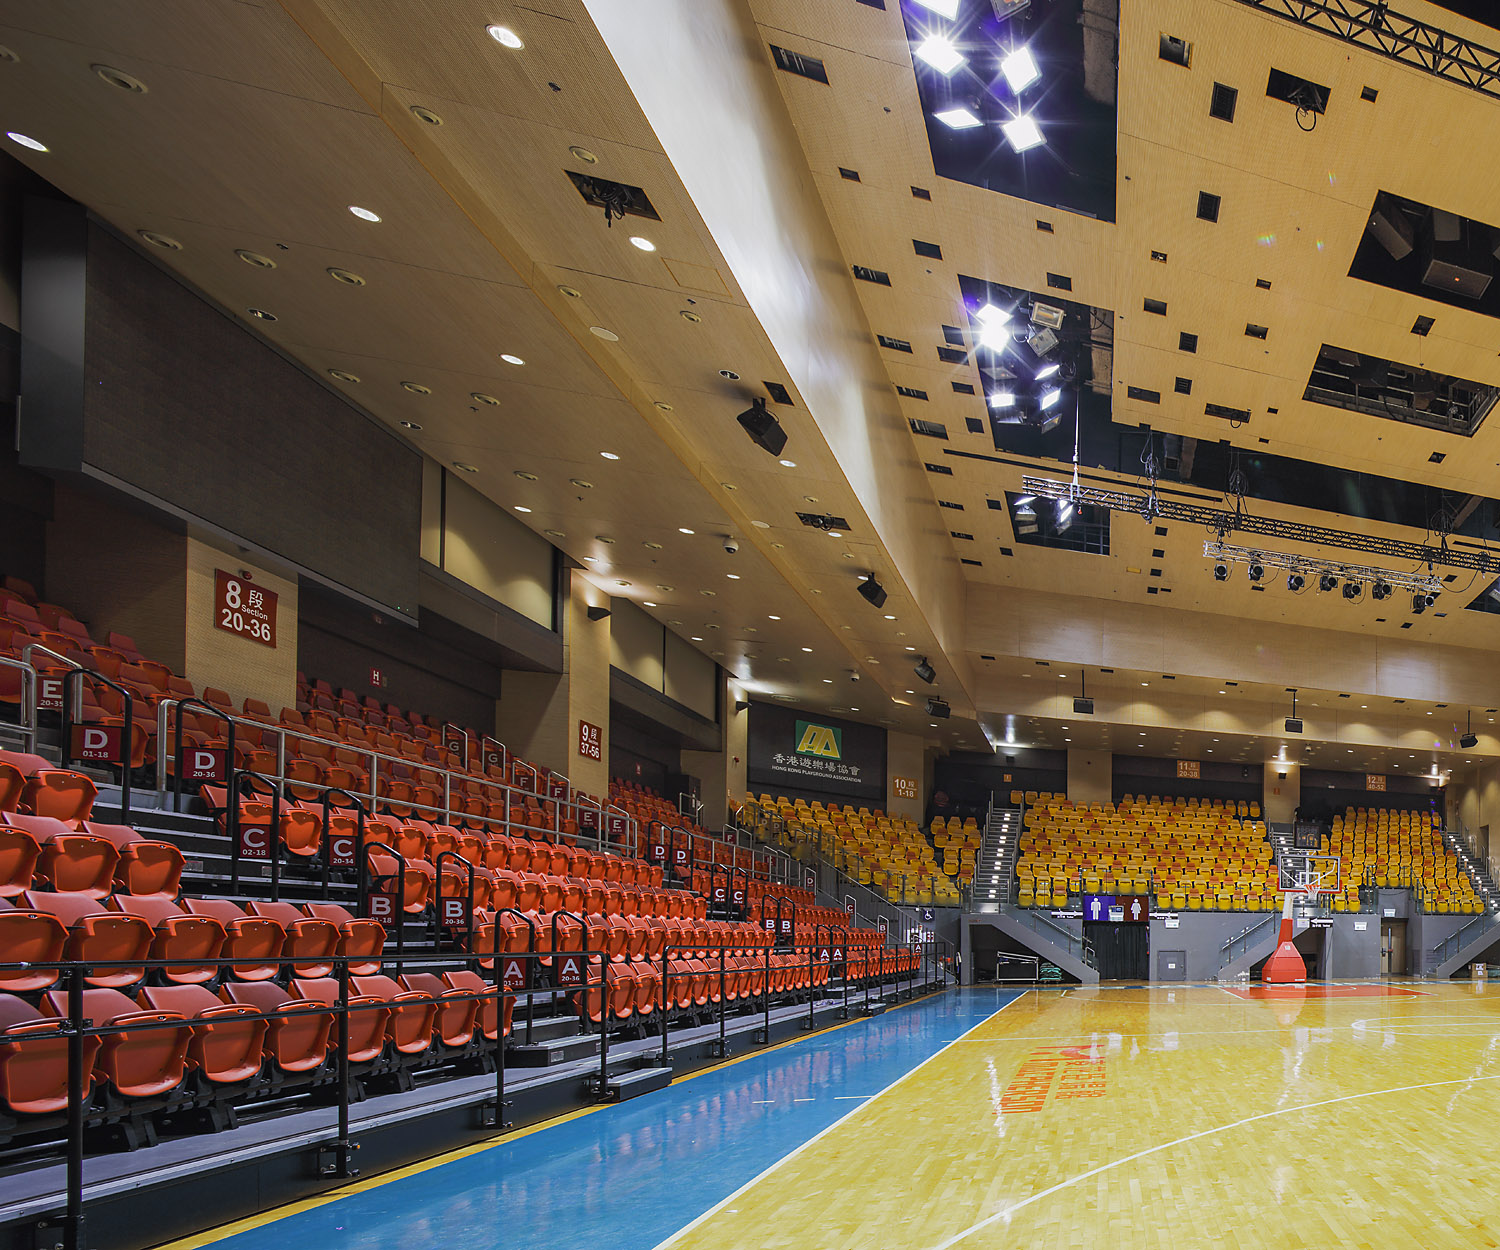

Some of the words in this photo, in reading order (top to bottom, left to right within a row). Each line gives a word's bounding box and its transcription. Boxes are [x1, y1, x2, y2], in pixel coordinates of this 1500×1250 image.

[226, 580, 242, 609] 8
[248, 590, 264, 610] 段
[241, 604, 268, 621] Section
[222, 608, 271, 642] 20-36
[374, 670, 379, 681] H
[42, 680, 62, 699] E
[582, 724, 589, 742] 9
[84, 730, 108, 749] D
[449, 742, 459, 751] G
[581, 742, 600, 758] 37-56
[195, 752, 216, 770] D
[488, 753, 498, 763] G
[802, 770, 832, 779] PLAYGROUND
[833, 774, 862, 783] ASSOCIATION
[520, 777, 528, 787] F
[894, 779, 906, 789] 10
[554, 788, 562, 796] F
[898, 789, 913, 797] 1-18
[584, 812, 592, 821] E
[613, 820, 621, 828] E
[244, 828, 266, 848] C
[334, 840, 353, 857] C
[656, 846, 664, 856] D
[677, 851, 686, 859] D
[715, 889, 724, 898] C
[734, 891, 743, 901] C
[371, 897, 391, 915] B
[446, 901, 464, 917] B
[766, 920, 775, 928] B
[782, 921, 791, 929] B
[821, 949, 829, 958] A
[834, 948, 842, 957] A
[504, 961, 523, 978] A
[562, 958, 579, 974] A
